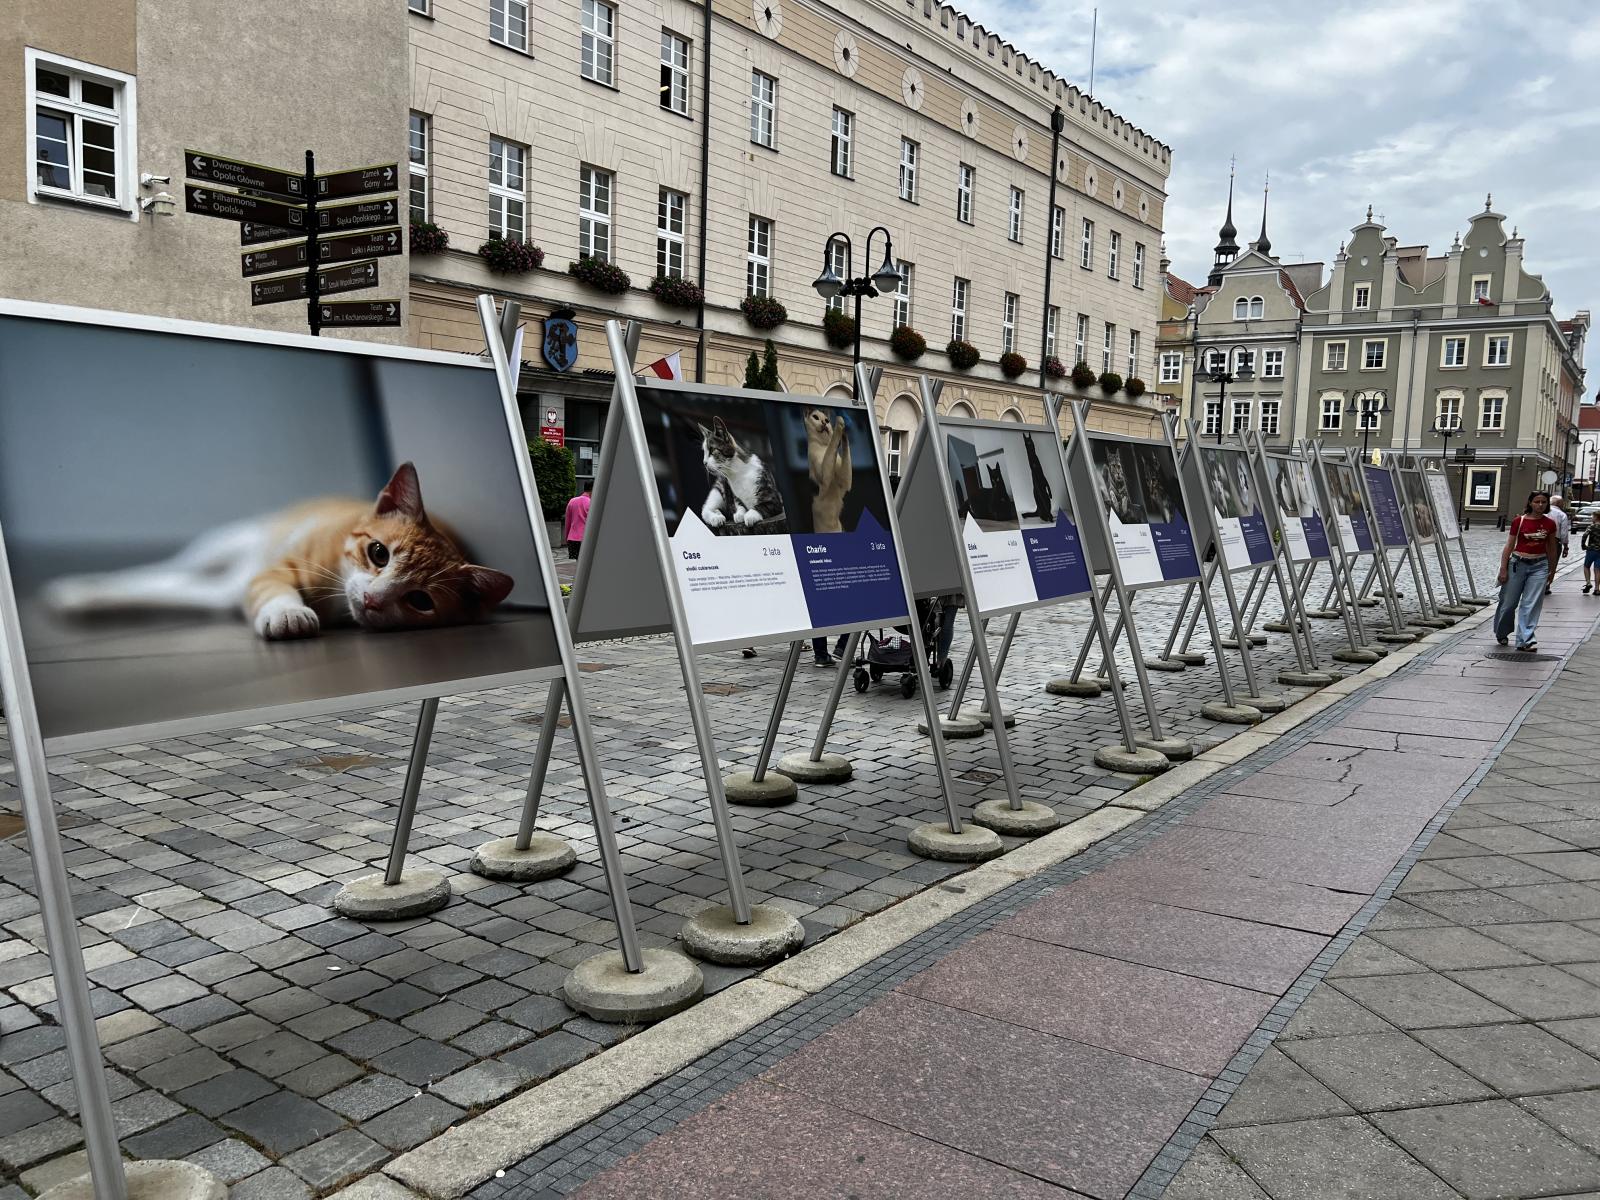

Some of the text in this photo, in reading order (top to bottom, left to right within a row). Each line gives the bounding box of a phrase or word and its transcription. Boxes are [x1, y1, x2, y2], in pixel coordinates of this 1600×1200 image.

[212, 159, 246, 174] Dworzec
[362, 169, 380, 179] Zamek
[213, 170, 265, 188] Opole Główne
[364, 180, 380, 189] Górny
[212, 192, 257, 208] Filharmonia
[213, 202, 244, 215] Opolska
[358, 204, 381, 212] Muzeum
[352, 214, 381, 224] Opolskiego
[367, 245, 384, 253] Aktora
[370, 303, 383, 311] Teatr
[806, 545, 827, 554] Charlie
[870, 542, 886, 550] 3 lata
[682, 550, 701, 560] Case
[762, 547, 781, 556] 2 lata
